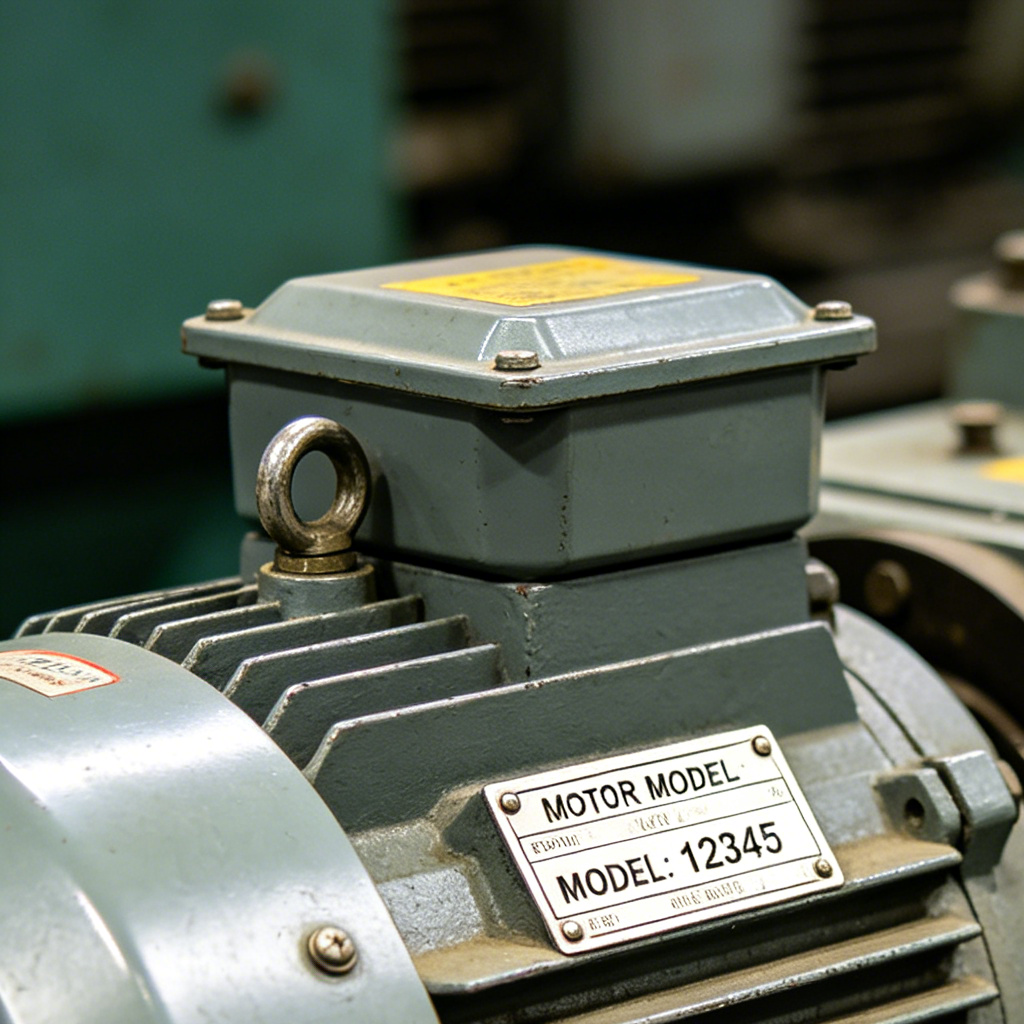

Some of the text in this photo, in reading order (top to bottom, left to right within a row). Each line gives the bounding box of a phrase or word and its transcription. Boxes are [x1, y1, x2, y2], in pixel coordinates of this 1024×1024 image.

[541, 780, 642, 823] MOTOR
[646, 759, 741, 801] MODEL
[556, 853, 674, 904] MODEL:
[681, 821, 783, 873] 12345
